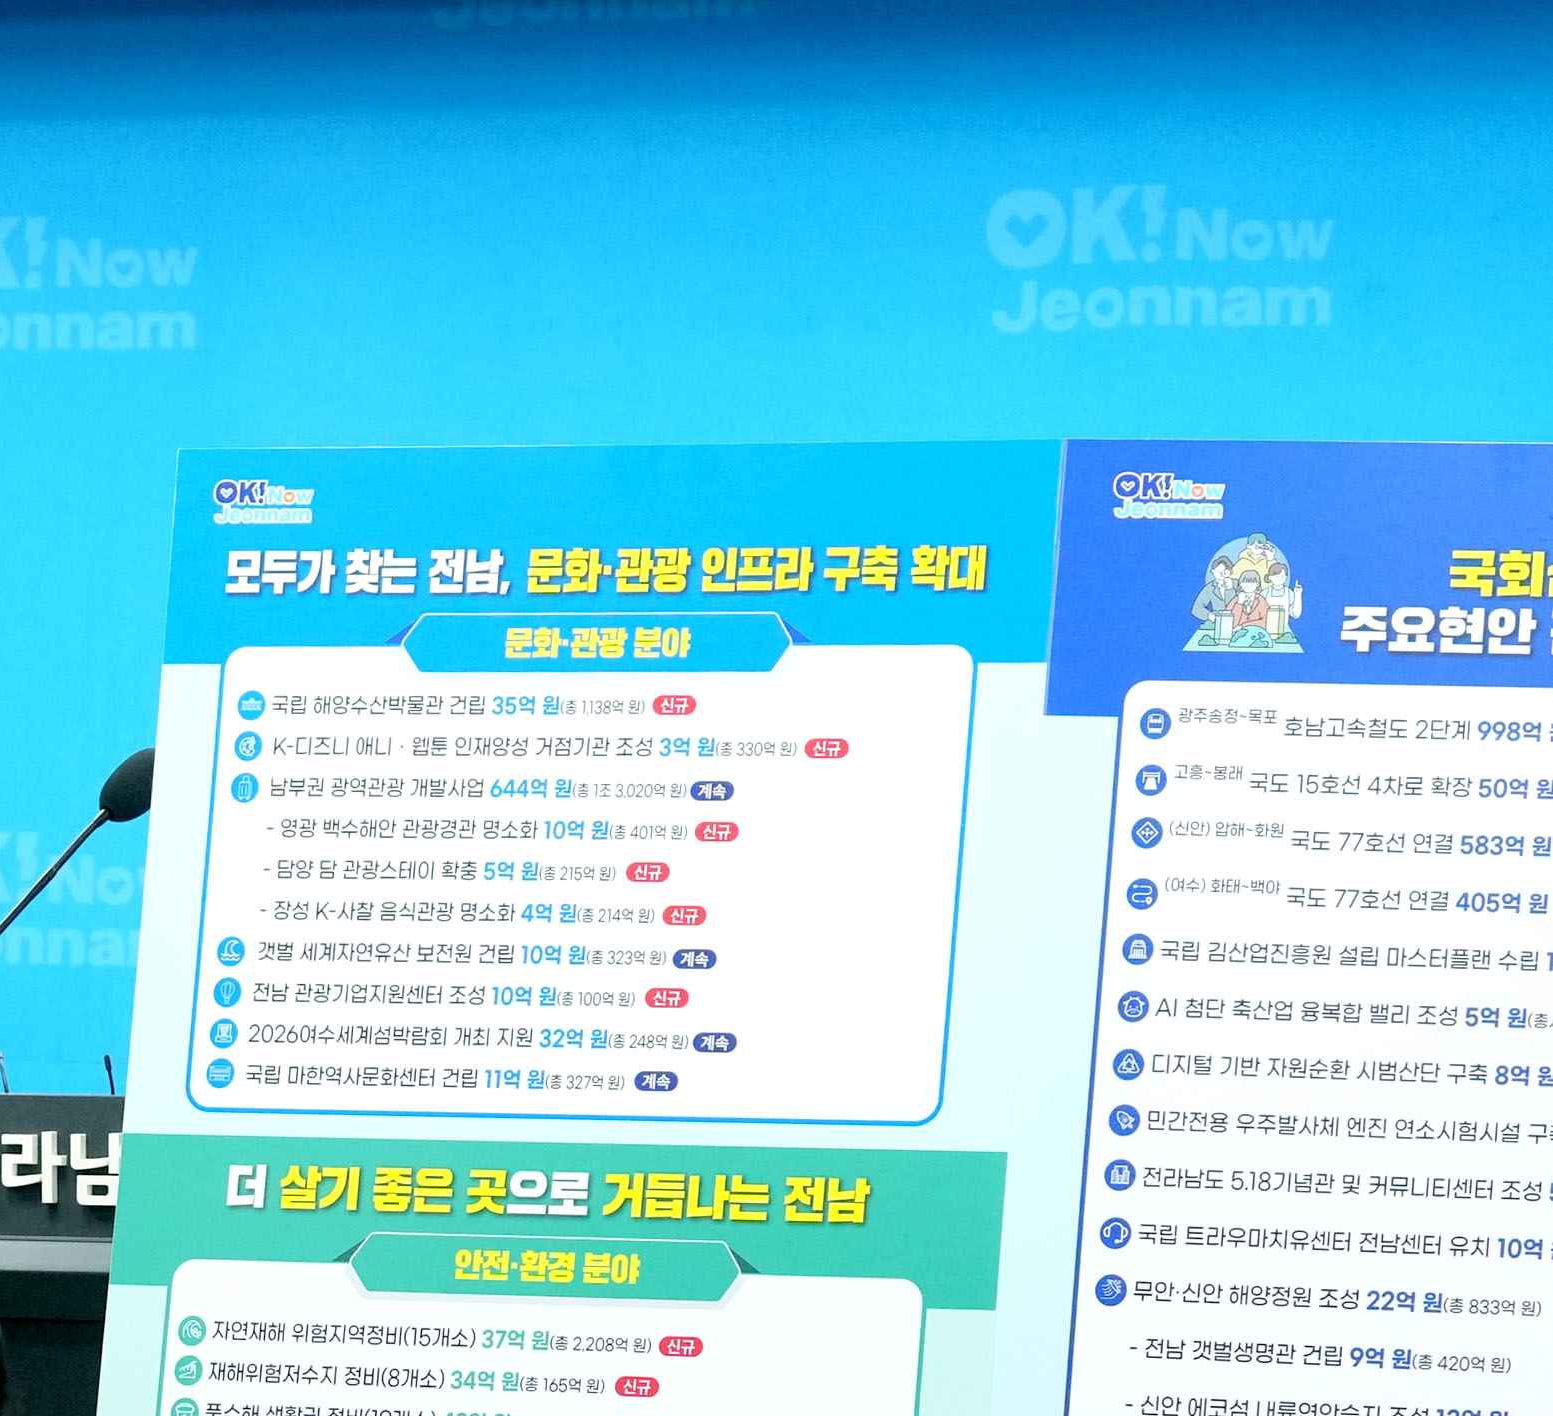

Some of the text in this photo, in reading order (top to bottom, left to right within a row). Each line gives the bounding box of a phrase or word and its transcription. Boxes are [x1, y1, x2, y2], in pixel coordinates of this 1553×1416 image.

[992, 280, 1331, 333] Jeonnam
[214, 479, 268, 505] OK!
[1114, 472, 1175, 499] OK!
[1114, 499, 1223, 519] Jeonnam
[225, 549, 338, 597] 모두가
[345, 548, 418, 595] 찾는
[429, 549, 511, 596] 전남,
[701, 546, 816, 595] 인프라
[823, 545, 901, 594] 구축
[910, 544, 989, 593] 확대
[633, 627, 691, 657] 분야
[1340, 606, 1536, 655] 주요현안
[271, 695, 535, 715] 국립 해양수산박물관 건립 35억
[660, 697, 690, 714] 신규
[1283, 716, 1407, 738] 호남고속철도
[1415, 719, 1470, 740] 2단계
[1477, 720, 1541, 742] 998억
[248, 1023, 583, 1048] 2026여수세계섬박람회 개최 지원 32억
[700, 1034, 731, 1051] 계속
[226, 1164, 872, 1226] 더 살기 좋은 곳으로 거듭나는 전남
[1142, 1167, 1542, 1201] 전라남도 5.18기념관 및 커뮤니티센터 조성
[582, 1252, 640, 1284] 분야
[1229, 1284, 1311, 1307] 해양정원
[1318, 1288, 1359, 1309] 조성
[1366, 1290, 1415, 1312] 22억
[1468, 1298, 1515, 1315] 833억
[1521, 1300, 1541, 1316] 원)
